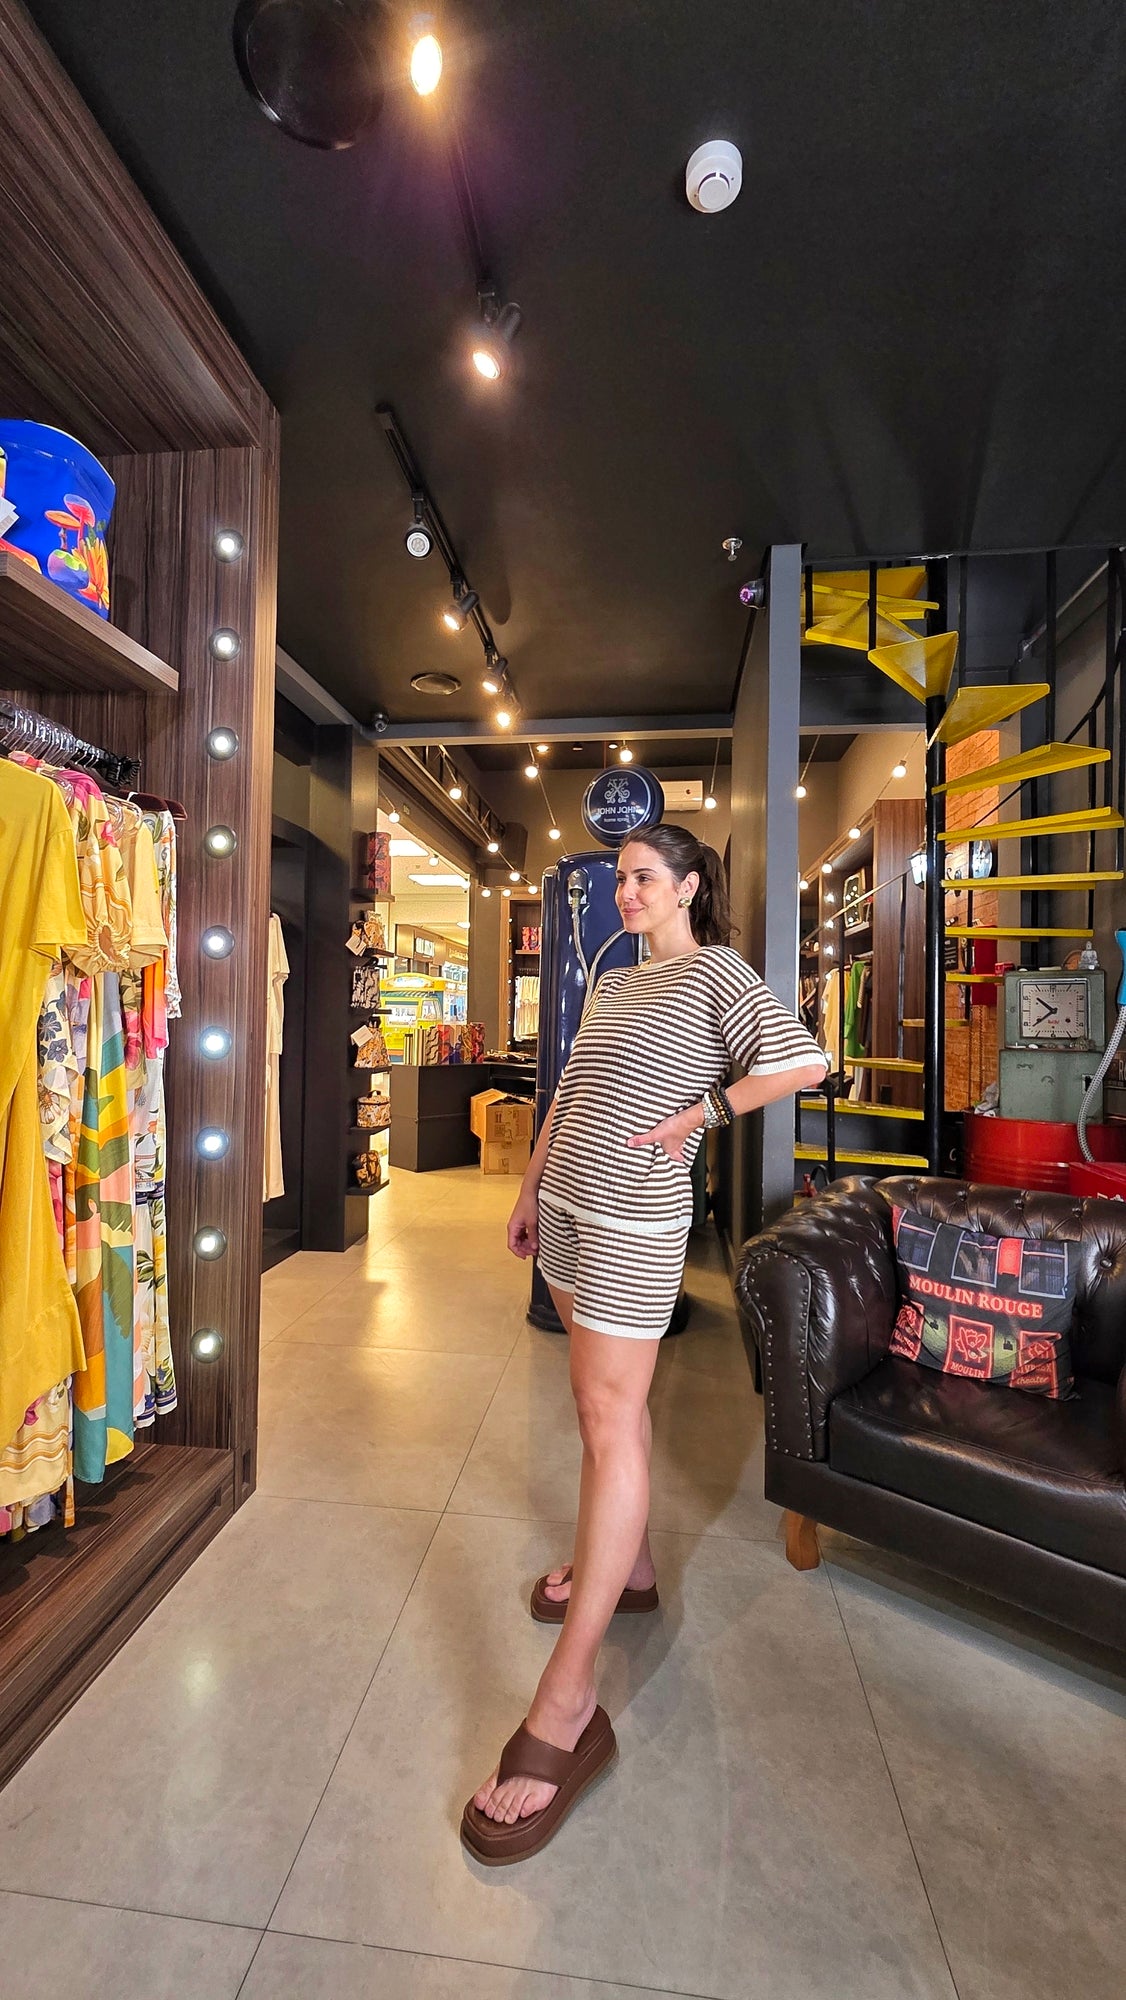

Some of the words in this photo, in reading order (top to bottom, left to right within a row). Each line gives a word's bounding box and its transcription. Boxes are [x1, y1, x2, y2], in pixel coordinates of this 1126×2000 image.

[909, 1274, 974, 1305] MOULIN
[977, 1293, 1043, 1318] ROUGE
[950, 1361, 985, 1379] MOULIN
